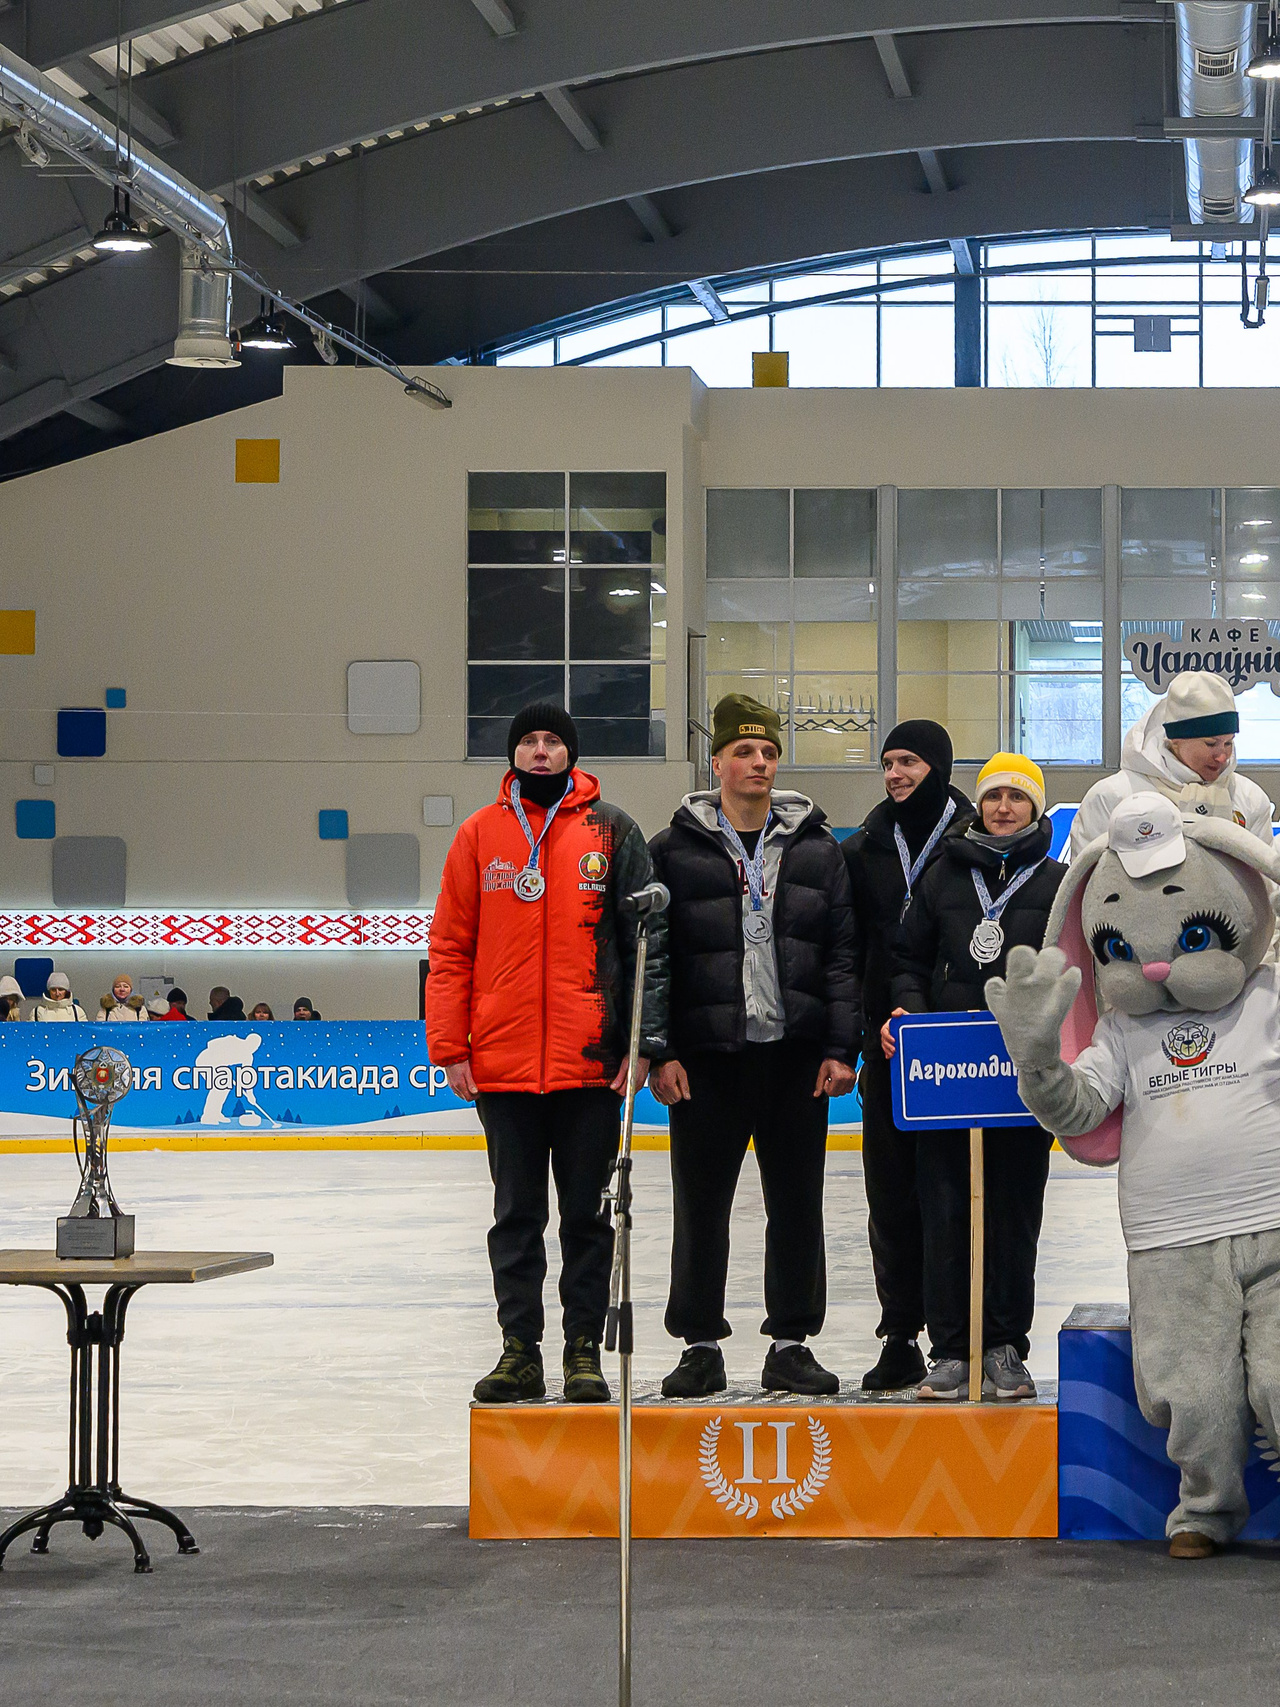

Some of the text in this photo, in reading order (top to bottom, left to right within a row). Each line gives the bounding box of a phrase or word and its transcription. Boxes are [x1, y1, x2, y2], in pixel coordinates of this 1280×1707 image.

[1191, 628, 1259, 642] КАФЕ
[578, 883, 606, 892] BELARUS
[172, 1065, 400, 1098] спартакиада
[1148, 1061, 1237, 1088] БЕЛЫЕ ТИГРЫ
[734, 1421, 796, 1484] II
